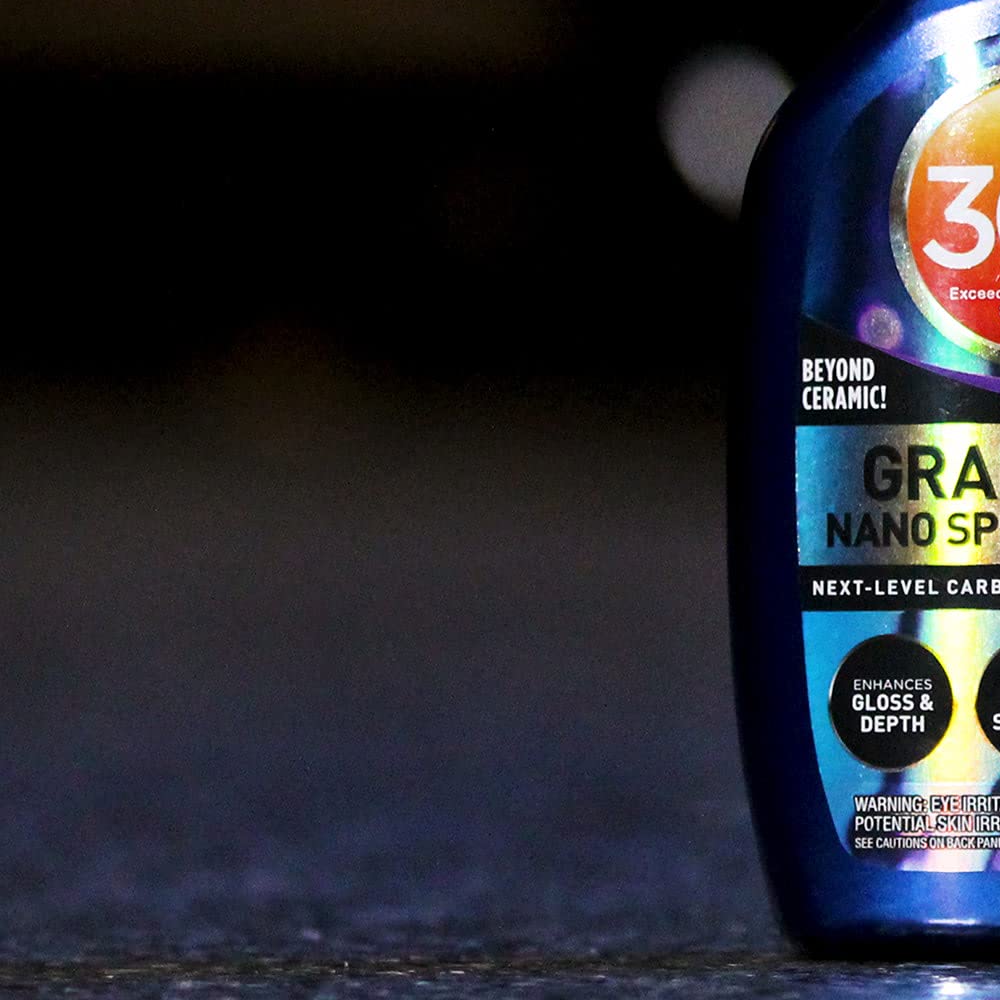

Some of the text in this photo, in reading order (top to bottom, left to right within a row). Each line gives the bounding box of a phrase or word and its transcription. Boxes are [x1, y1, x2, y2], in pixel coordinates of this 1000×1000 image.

[802, 358, 875, 382] BEYOND
[802, 385, 887, 410] CERAMIC!
[826, 511, 936, 548] NANO
[812, 578, 939, 596] NEXT-LEVEL
[853, 678, 933, 691] ENHANCES
[851, 693, 934, 712] GLOSS &
[860, 715, 926, 733] DEPTH
[854, 796, 928, 813] WARNING:
[930, 796, 960, 813] EYE
[854, 815, 934, 833] POTENTIAL
[936, 815, 973, 833] SKIN
[854, 837, 874, 849] SEE
[875, 837, 928, 849] CAUTIONS
[929, 837, 946, 849] ON
[947, 837, 976, 849] BACK
